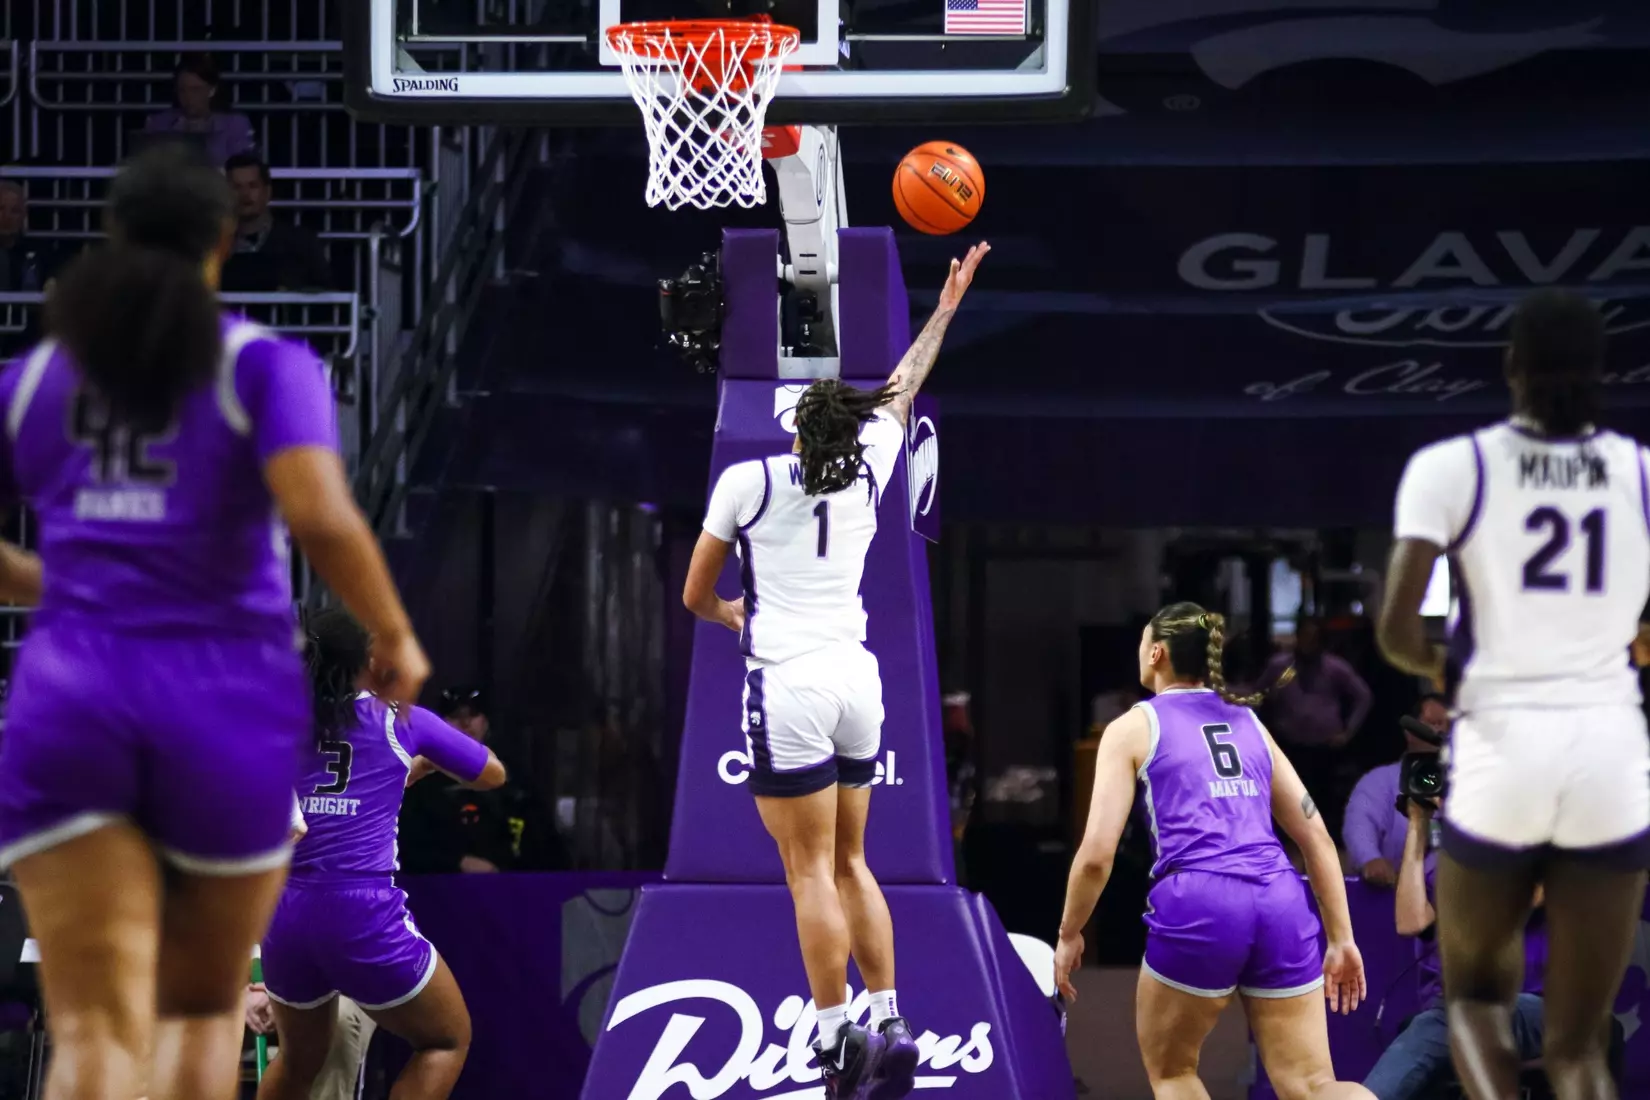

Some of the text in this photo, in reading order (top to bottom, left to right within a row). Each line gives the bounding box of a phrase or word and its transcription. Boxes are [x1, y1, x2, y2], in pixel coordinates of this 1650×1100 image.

[392, 78, 459, 93] SPALDING
[1177, 226, 1650, 291] GLAVA
[812, 499, 830, 560] 1
[1521, 503, 1608, 595] 21
[313, 739, 353, 795] 3
[1201, 723, 1243, 780] 6
[606, 978, 994, 1100] Dilns
